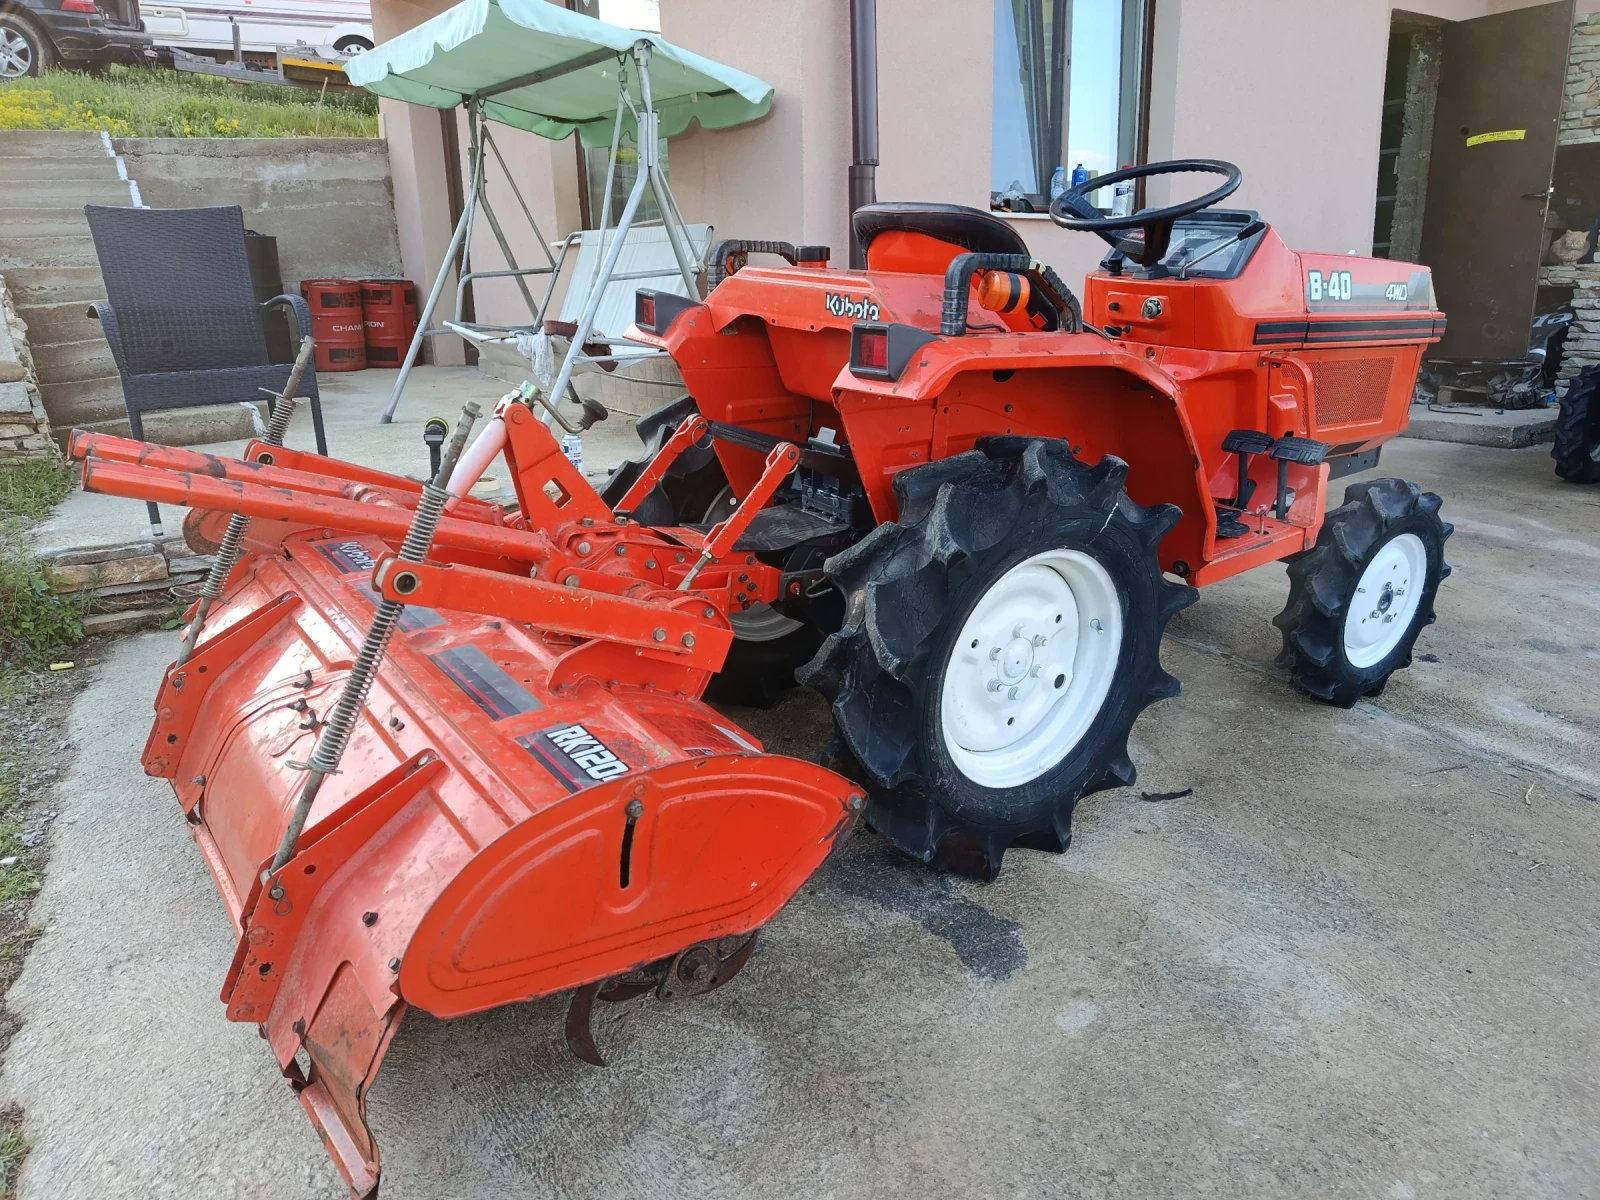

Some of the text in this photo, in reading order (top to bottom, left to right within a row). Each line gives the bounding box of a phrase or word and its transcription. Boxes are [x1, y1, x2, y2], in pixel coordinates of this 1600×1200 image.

[1309, 271, 1351, 300] B-40
[1385, 283, 1408, 300] 4WD
[826, 293, 879, 320] Kubota
[339, 541, 376, 570] Kubota
